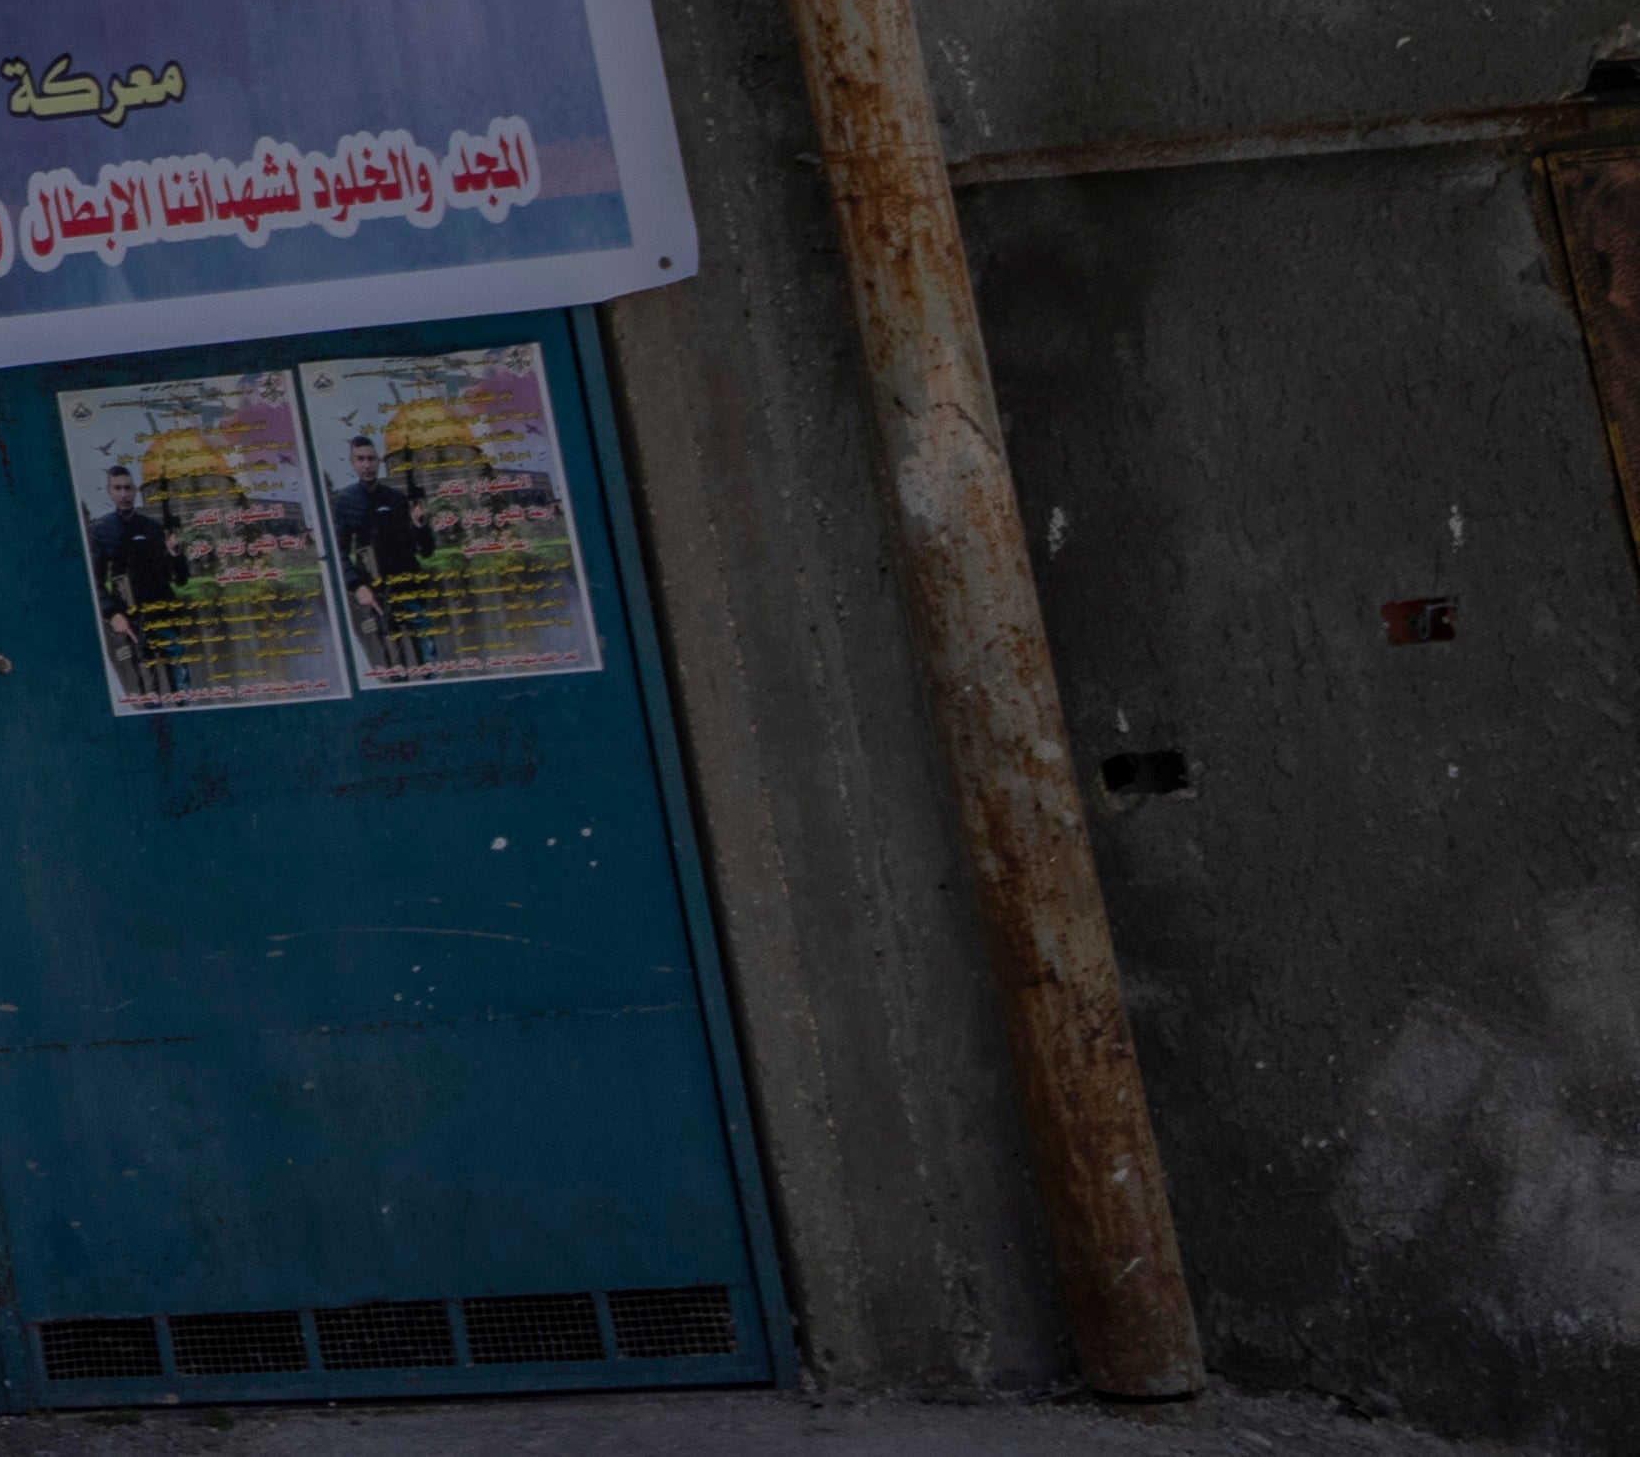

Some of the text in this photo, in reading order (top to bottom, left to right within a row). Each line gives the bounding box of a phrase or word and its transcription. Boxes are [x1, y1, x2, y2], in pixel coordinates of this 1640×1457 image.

[1, 54, 185, 128] معركة
[157, 151, 302, 233] لشهدائنا
[312, 145, 434, 222] والخلود
[451, 131, 530, 208] المجد
[30, 172, 153, 257] الابطال
